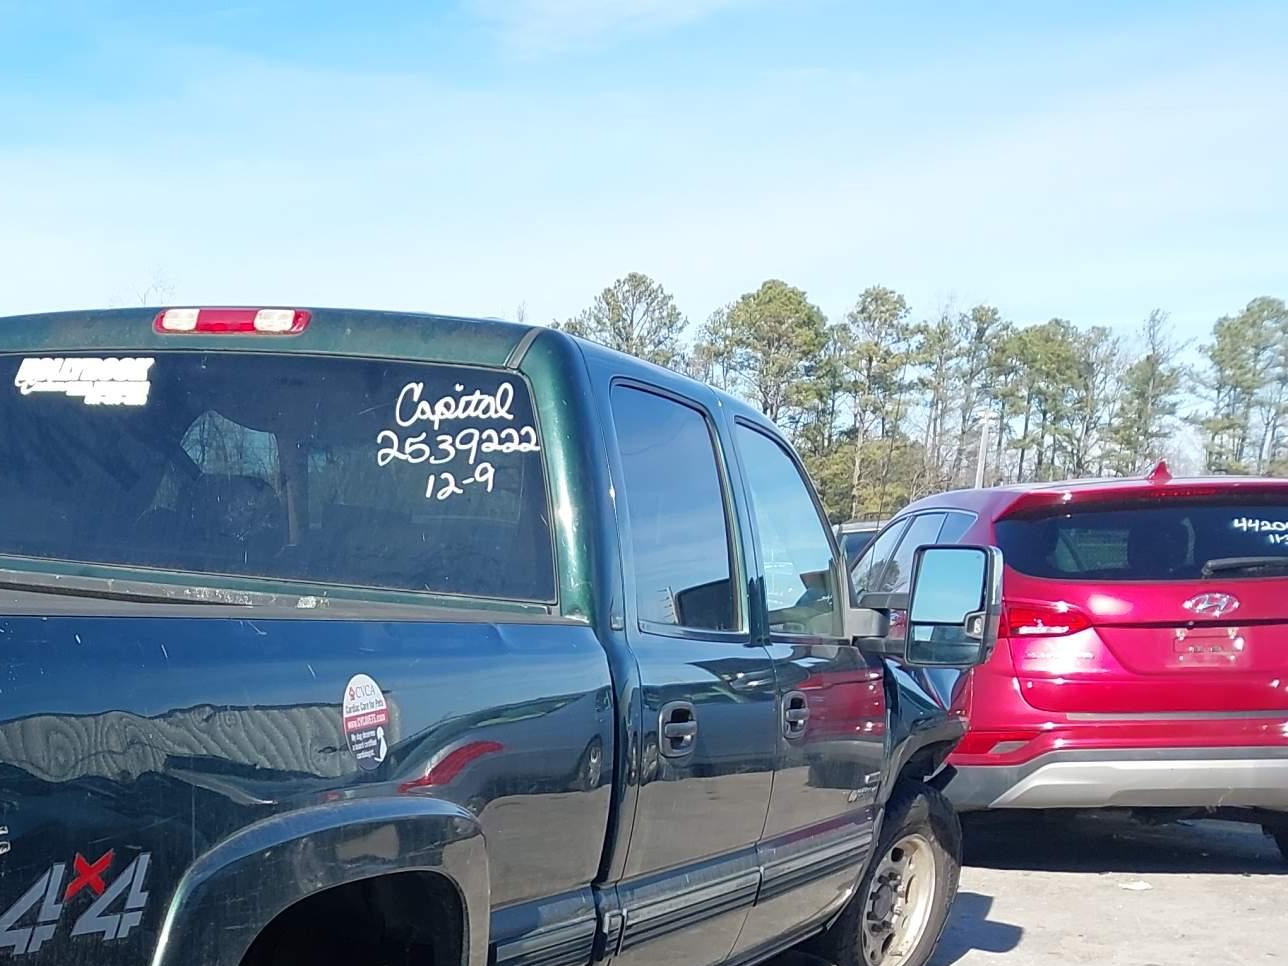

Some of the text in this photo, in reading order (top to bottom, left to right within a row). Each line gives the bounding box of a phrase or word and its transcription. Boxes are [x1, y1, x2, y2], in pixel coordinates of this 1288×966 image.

[395, 382, 514, 430] Capital
[376, 425, 541, 466] 2539222
[425, 462, 496, 500] 12-9
